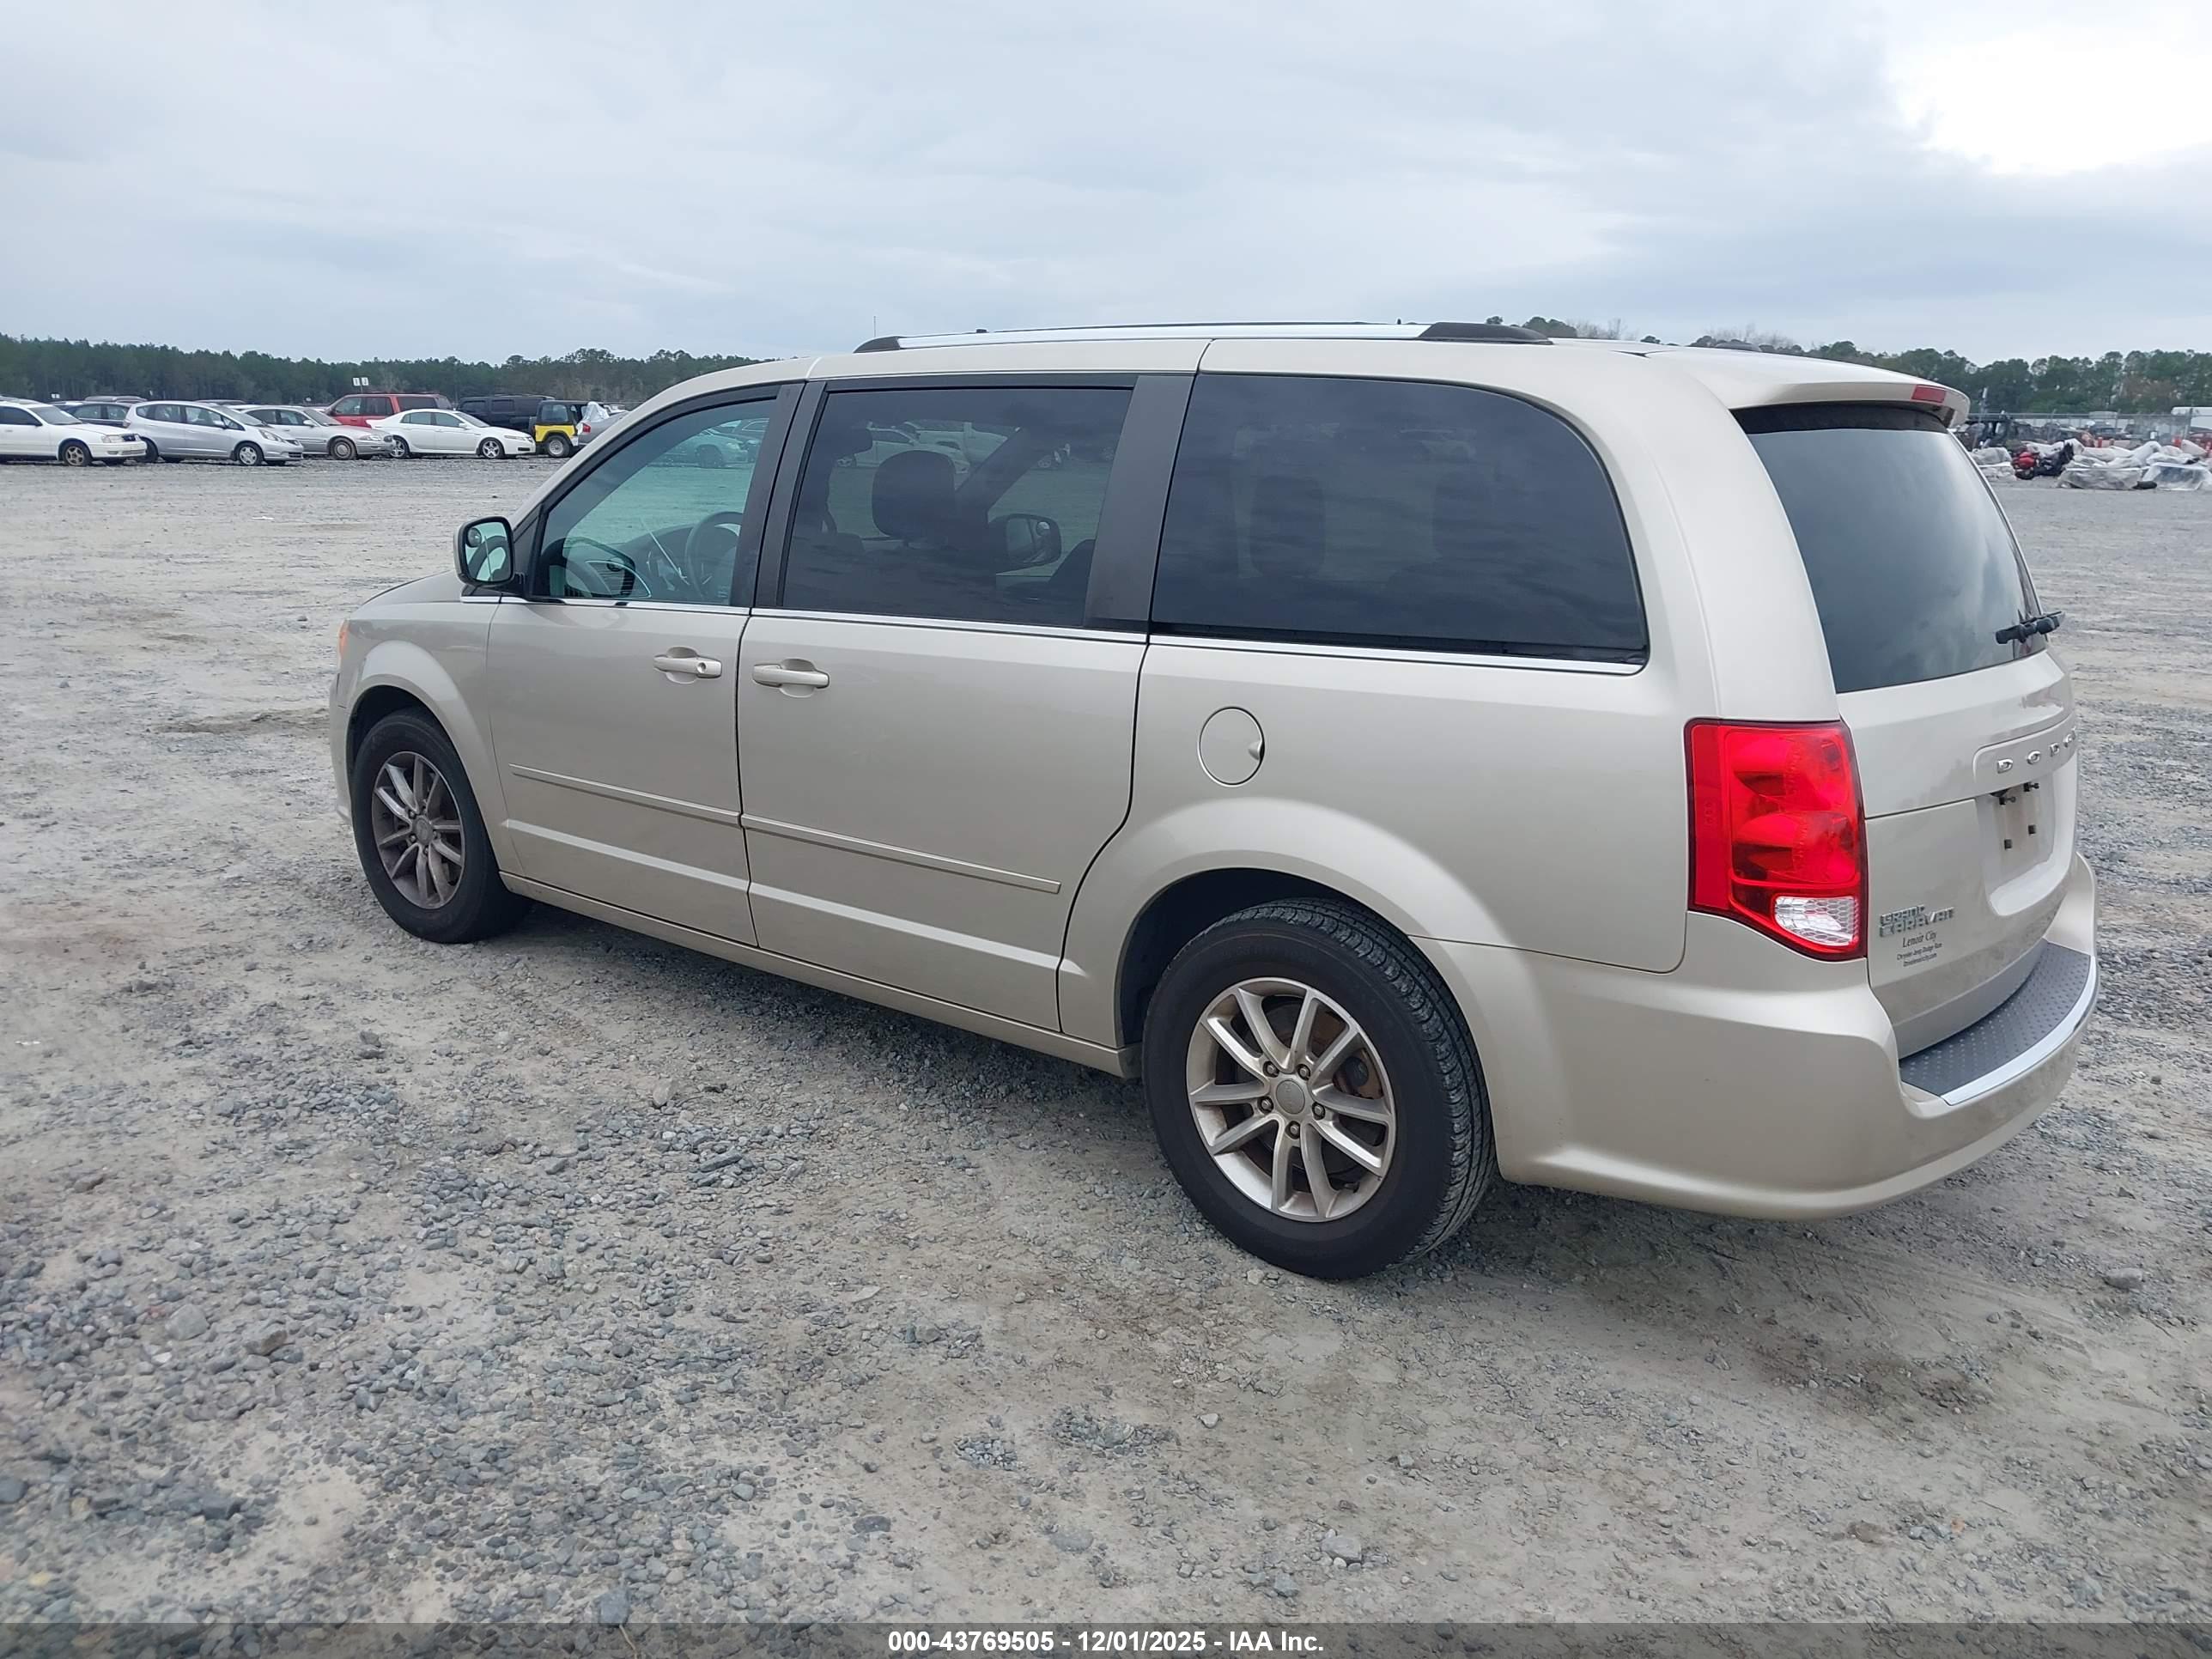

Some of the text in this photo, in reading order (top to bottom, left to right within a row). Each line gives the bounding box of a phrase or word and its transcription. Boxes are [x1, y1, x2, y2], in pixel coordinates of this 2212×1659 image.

[1879, 907, 1954, 937] CARAVAN
[1880, 904, 1925, 927] GRAND
[1925, 930, 1937, 942] City
